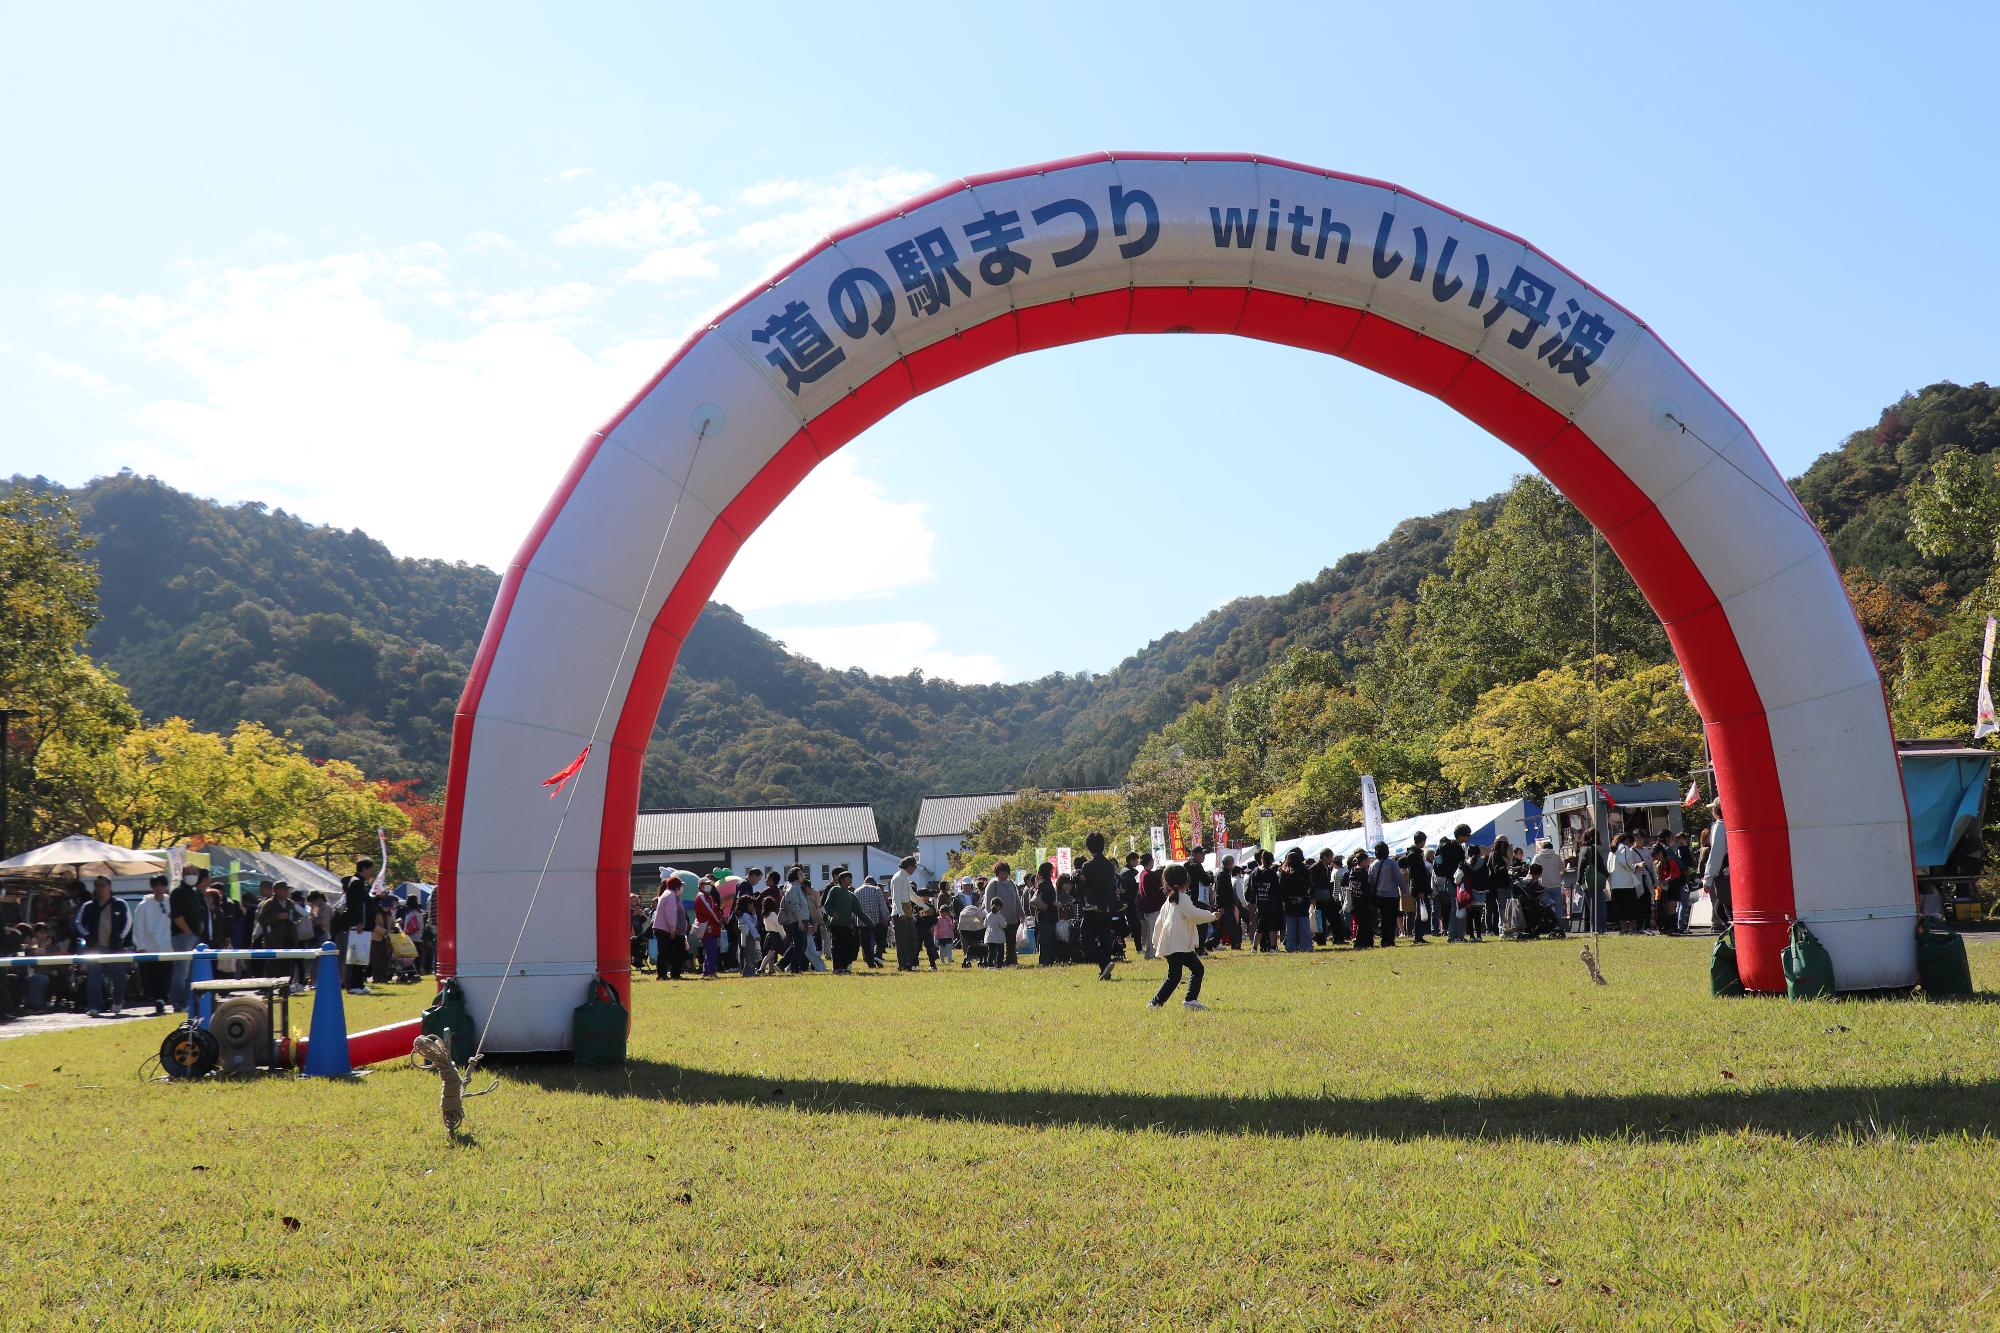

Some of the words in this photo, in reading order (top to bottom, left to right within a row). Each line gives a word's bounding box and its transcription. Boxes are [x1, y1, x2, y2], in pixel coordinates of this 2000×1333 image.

[752, 185, 1160, 396] 道の駅まつり
[1209, 199, 1352, 265] with
[1372, 212, 1615, 387] いい丹波
